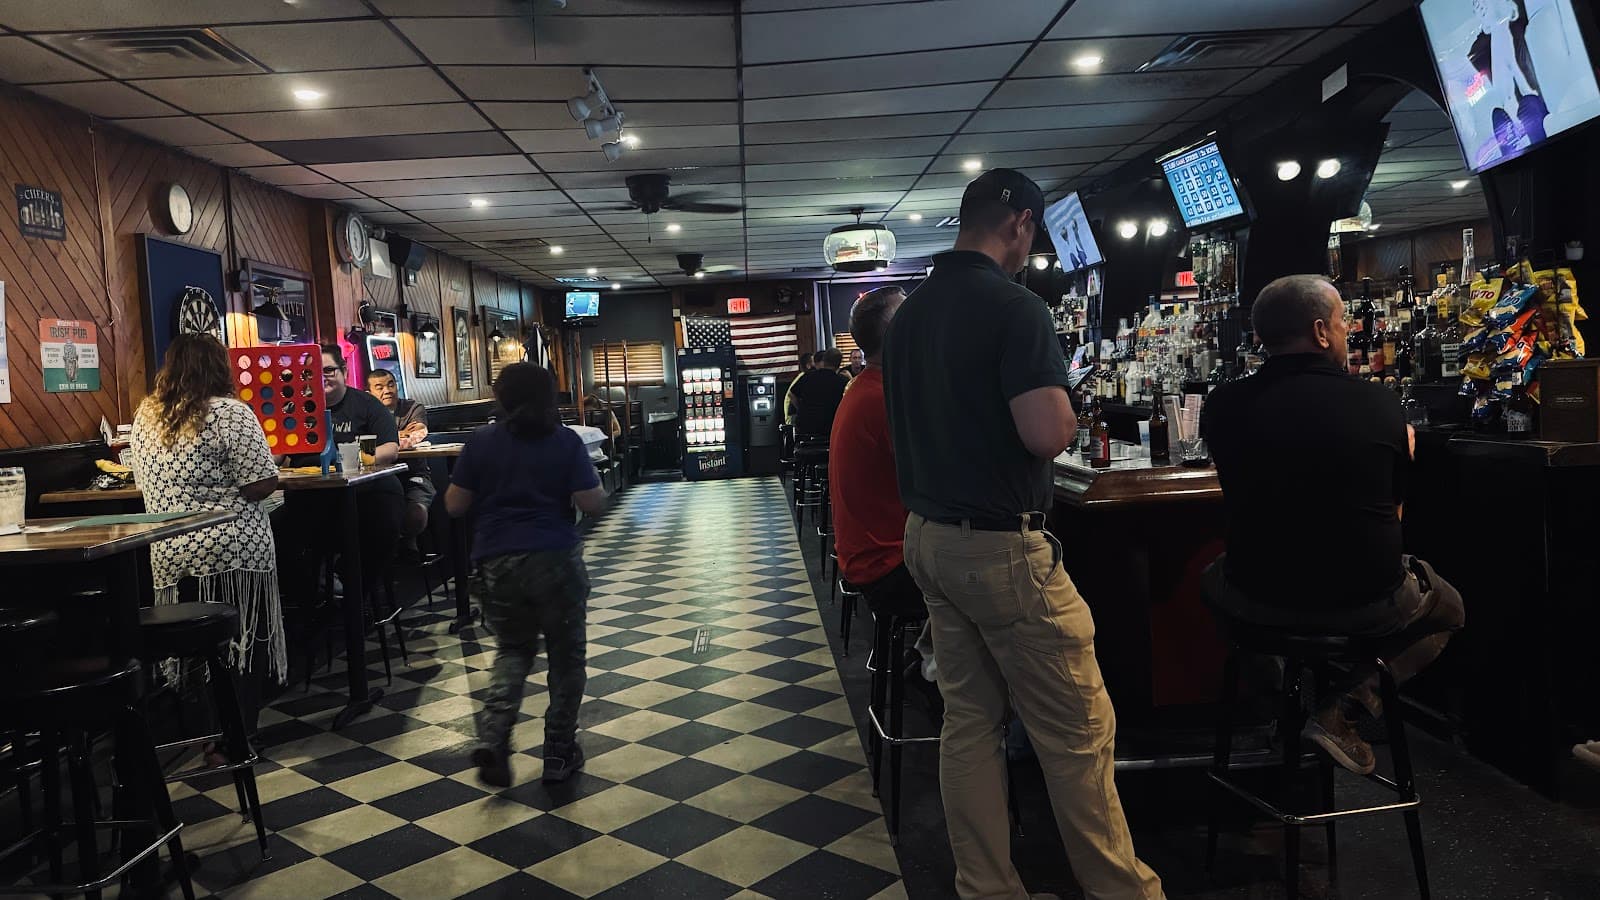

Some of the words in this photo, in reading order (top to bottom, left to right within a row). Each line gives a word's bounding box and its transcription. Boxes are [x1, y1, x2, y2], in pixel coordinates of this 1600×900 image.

[24, 188, 55, 204] CHEERS
[730, 298, 749, 313] EXIT
[49, 326, 70, 338] IRISH
[73, 328, 88, 339] PUB
[698, 455, 726, 471] Instant
